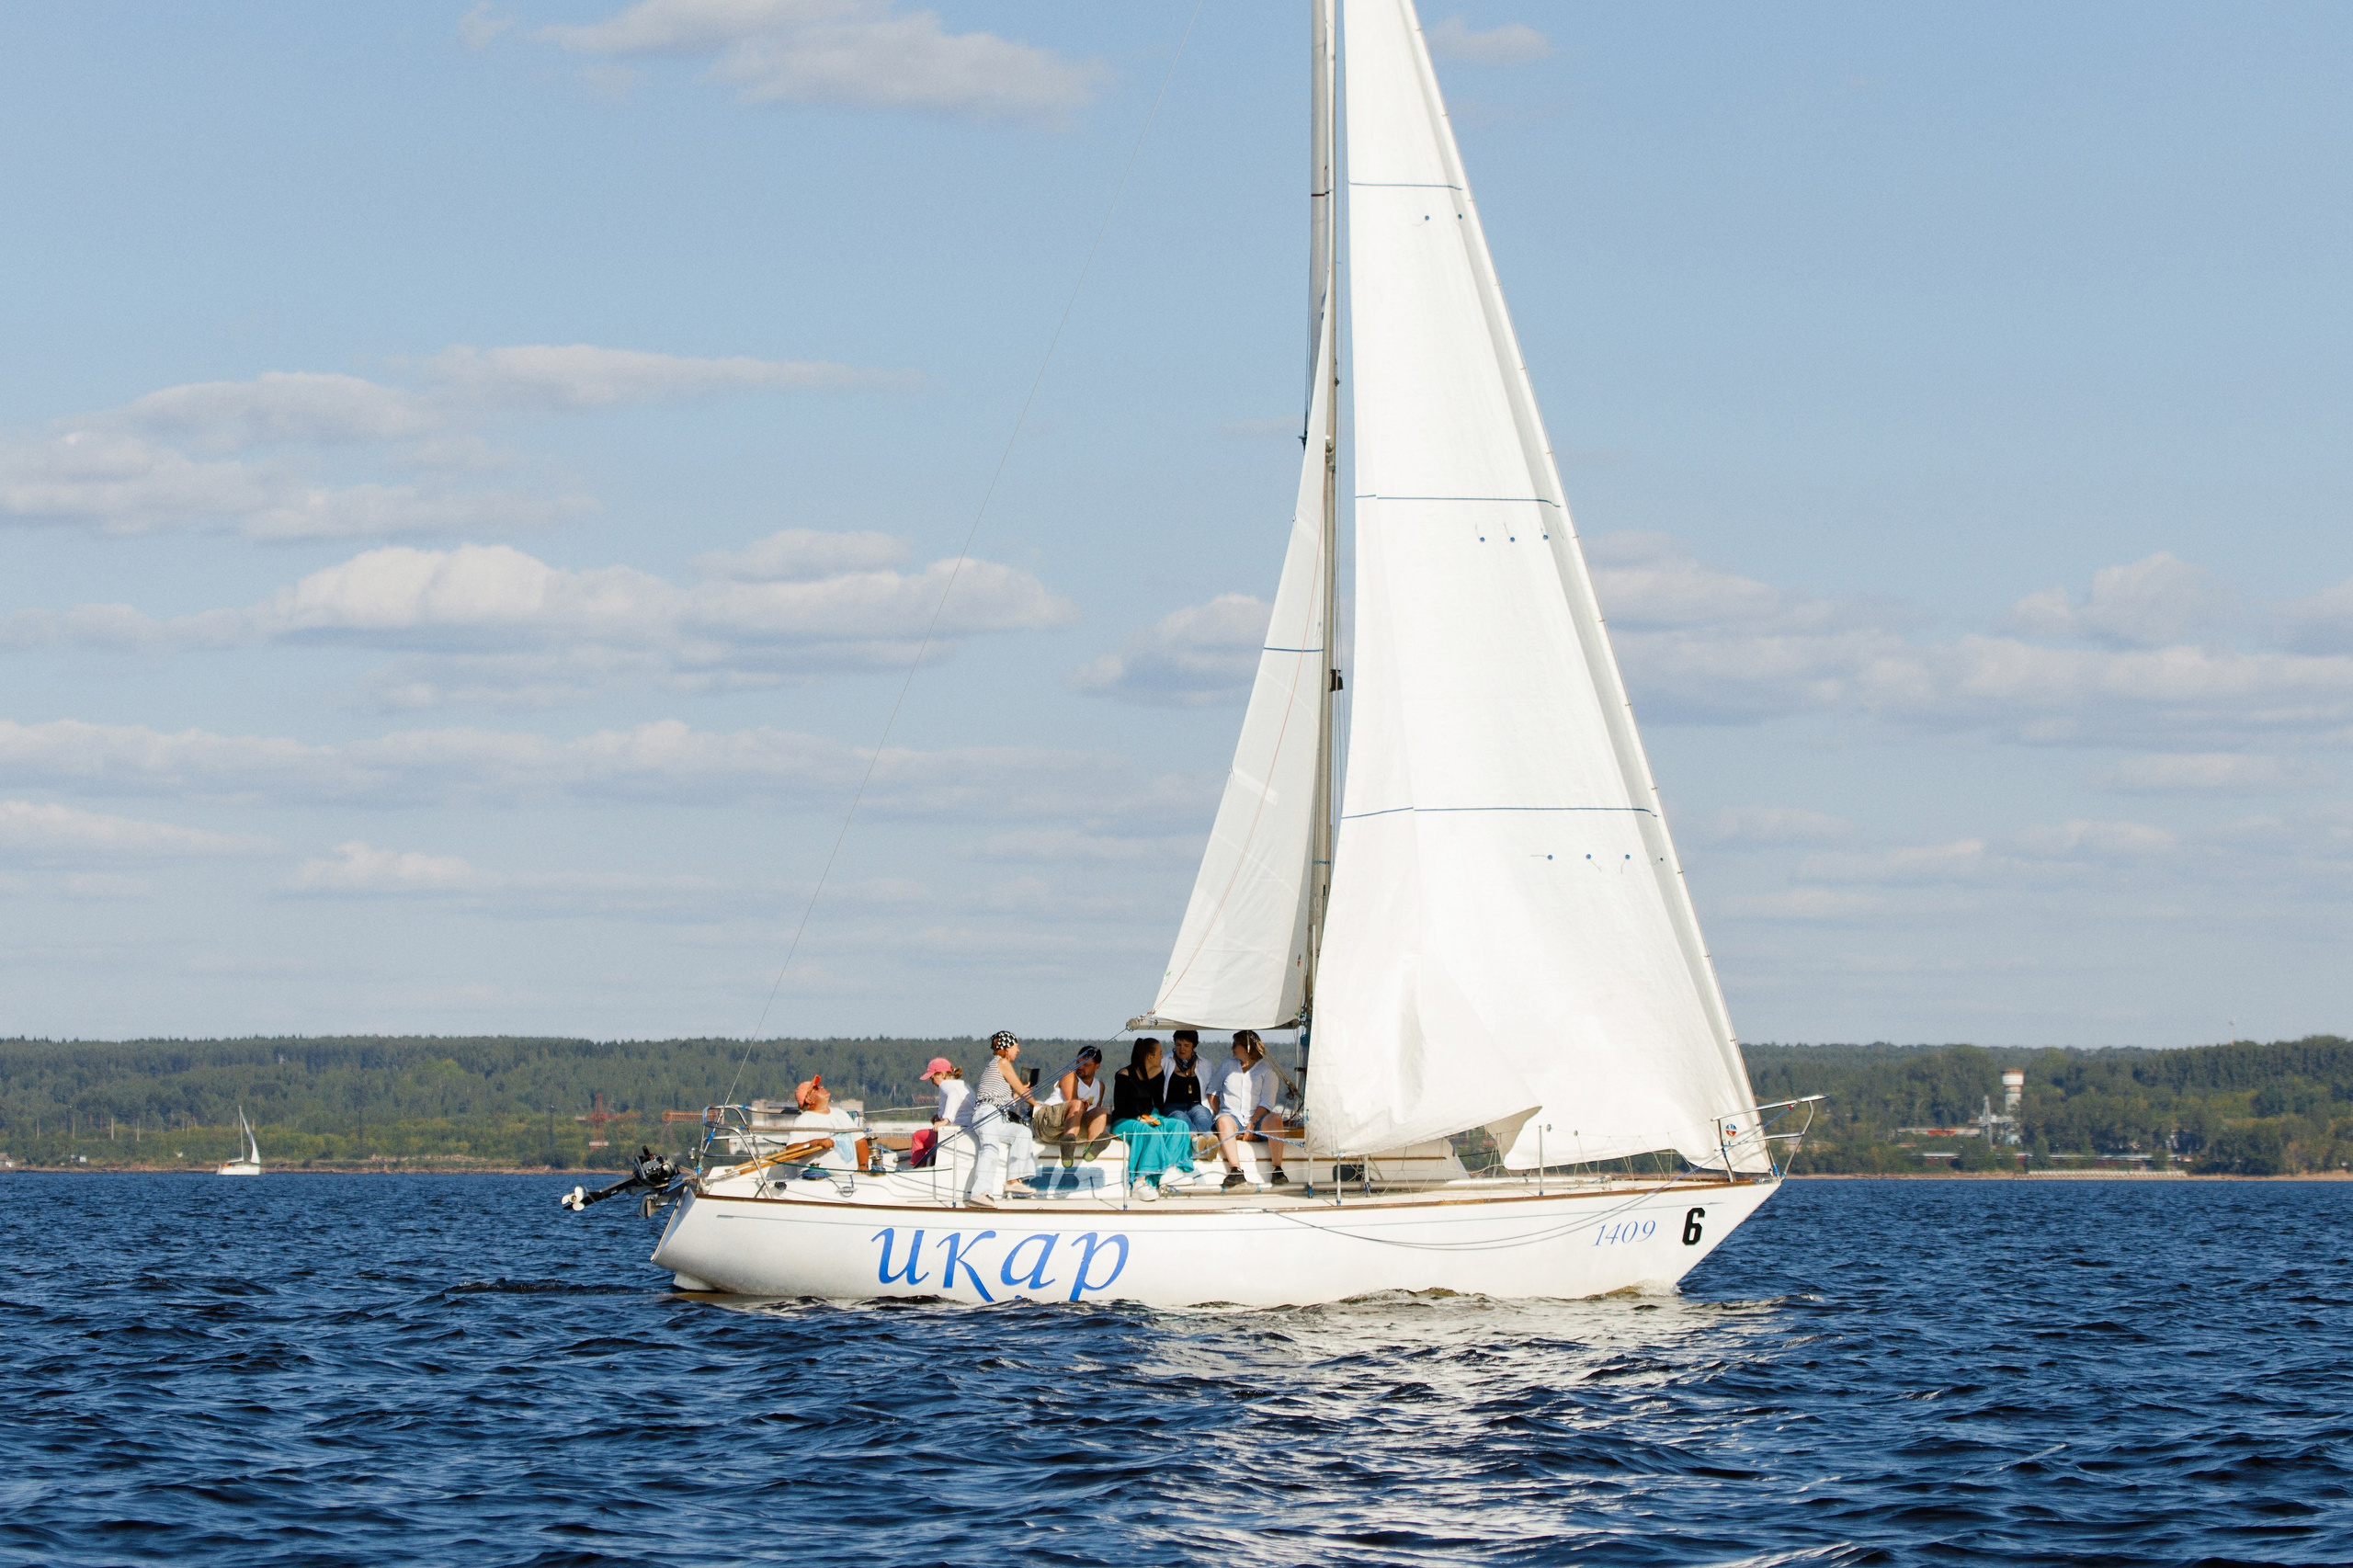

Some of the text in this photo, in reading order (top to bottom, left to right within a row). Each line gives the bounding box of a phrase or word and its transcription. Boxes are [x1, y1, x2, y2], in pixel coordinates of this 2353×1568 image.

[1591, 1220, 1656, 1246] 1409
[1682, 1207, 1706, 1245] 6
[871, 1228, 1130, 1302] икар
